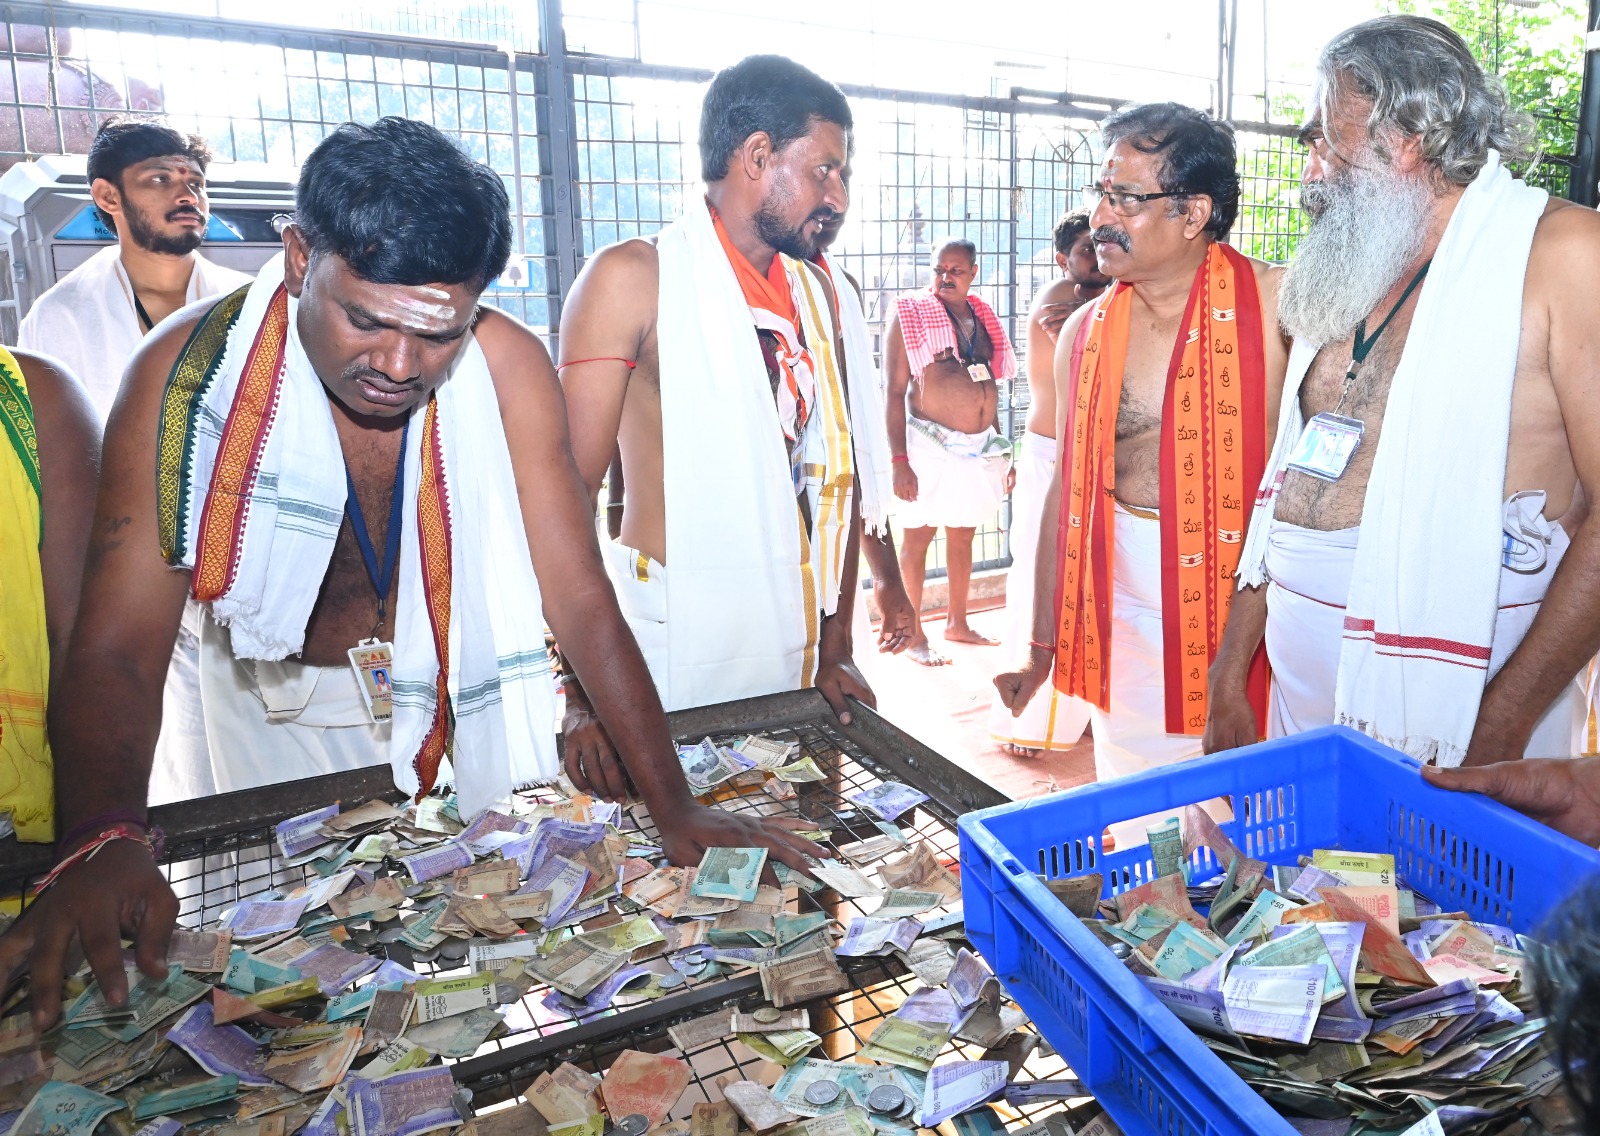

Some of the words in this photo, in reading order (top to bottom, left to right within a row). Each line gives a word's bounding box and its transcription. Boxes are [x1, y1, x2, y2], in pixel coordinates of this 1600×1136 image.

[1215, 339, 1233, 354] ఓం
[1178, 363, 1195, 380] ఓం
[1183, 588, 1201, 604] ఓం
[1381, 869, 1389, 884] ₹20
[482, 982, 490, 995] ₹20
[1306, 976, 1318, 996] ₹100
[1211, 1005, 1225, 1028] ₹100
